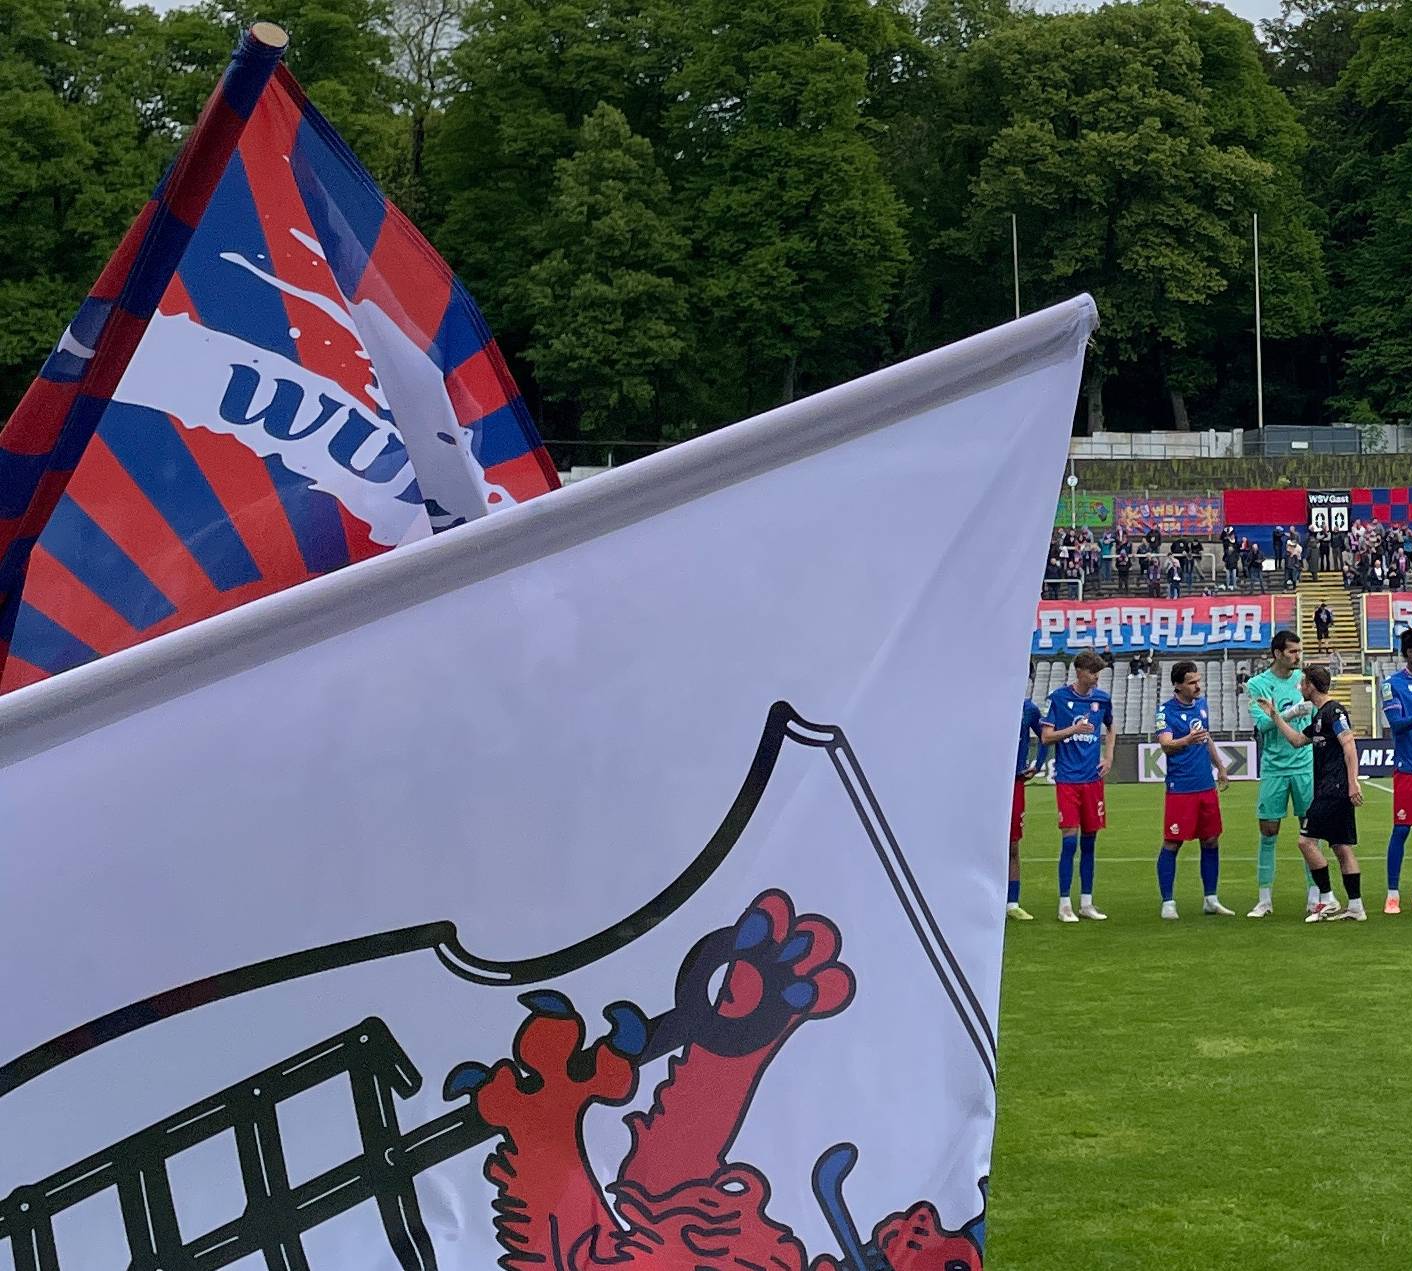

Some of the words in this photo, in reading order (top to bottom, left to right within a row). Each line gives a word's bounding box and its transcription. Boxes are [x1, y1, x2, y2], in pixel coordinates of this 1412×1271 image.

[1309, 495, 1328, 504] WSV
[1329, 494, 1349, 504] Gast
[1038, 604, 1263, 648] PERTALER
[1360, 749, 1383, 766] AM
